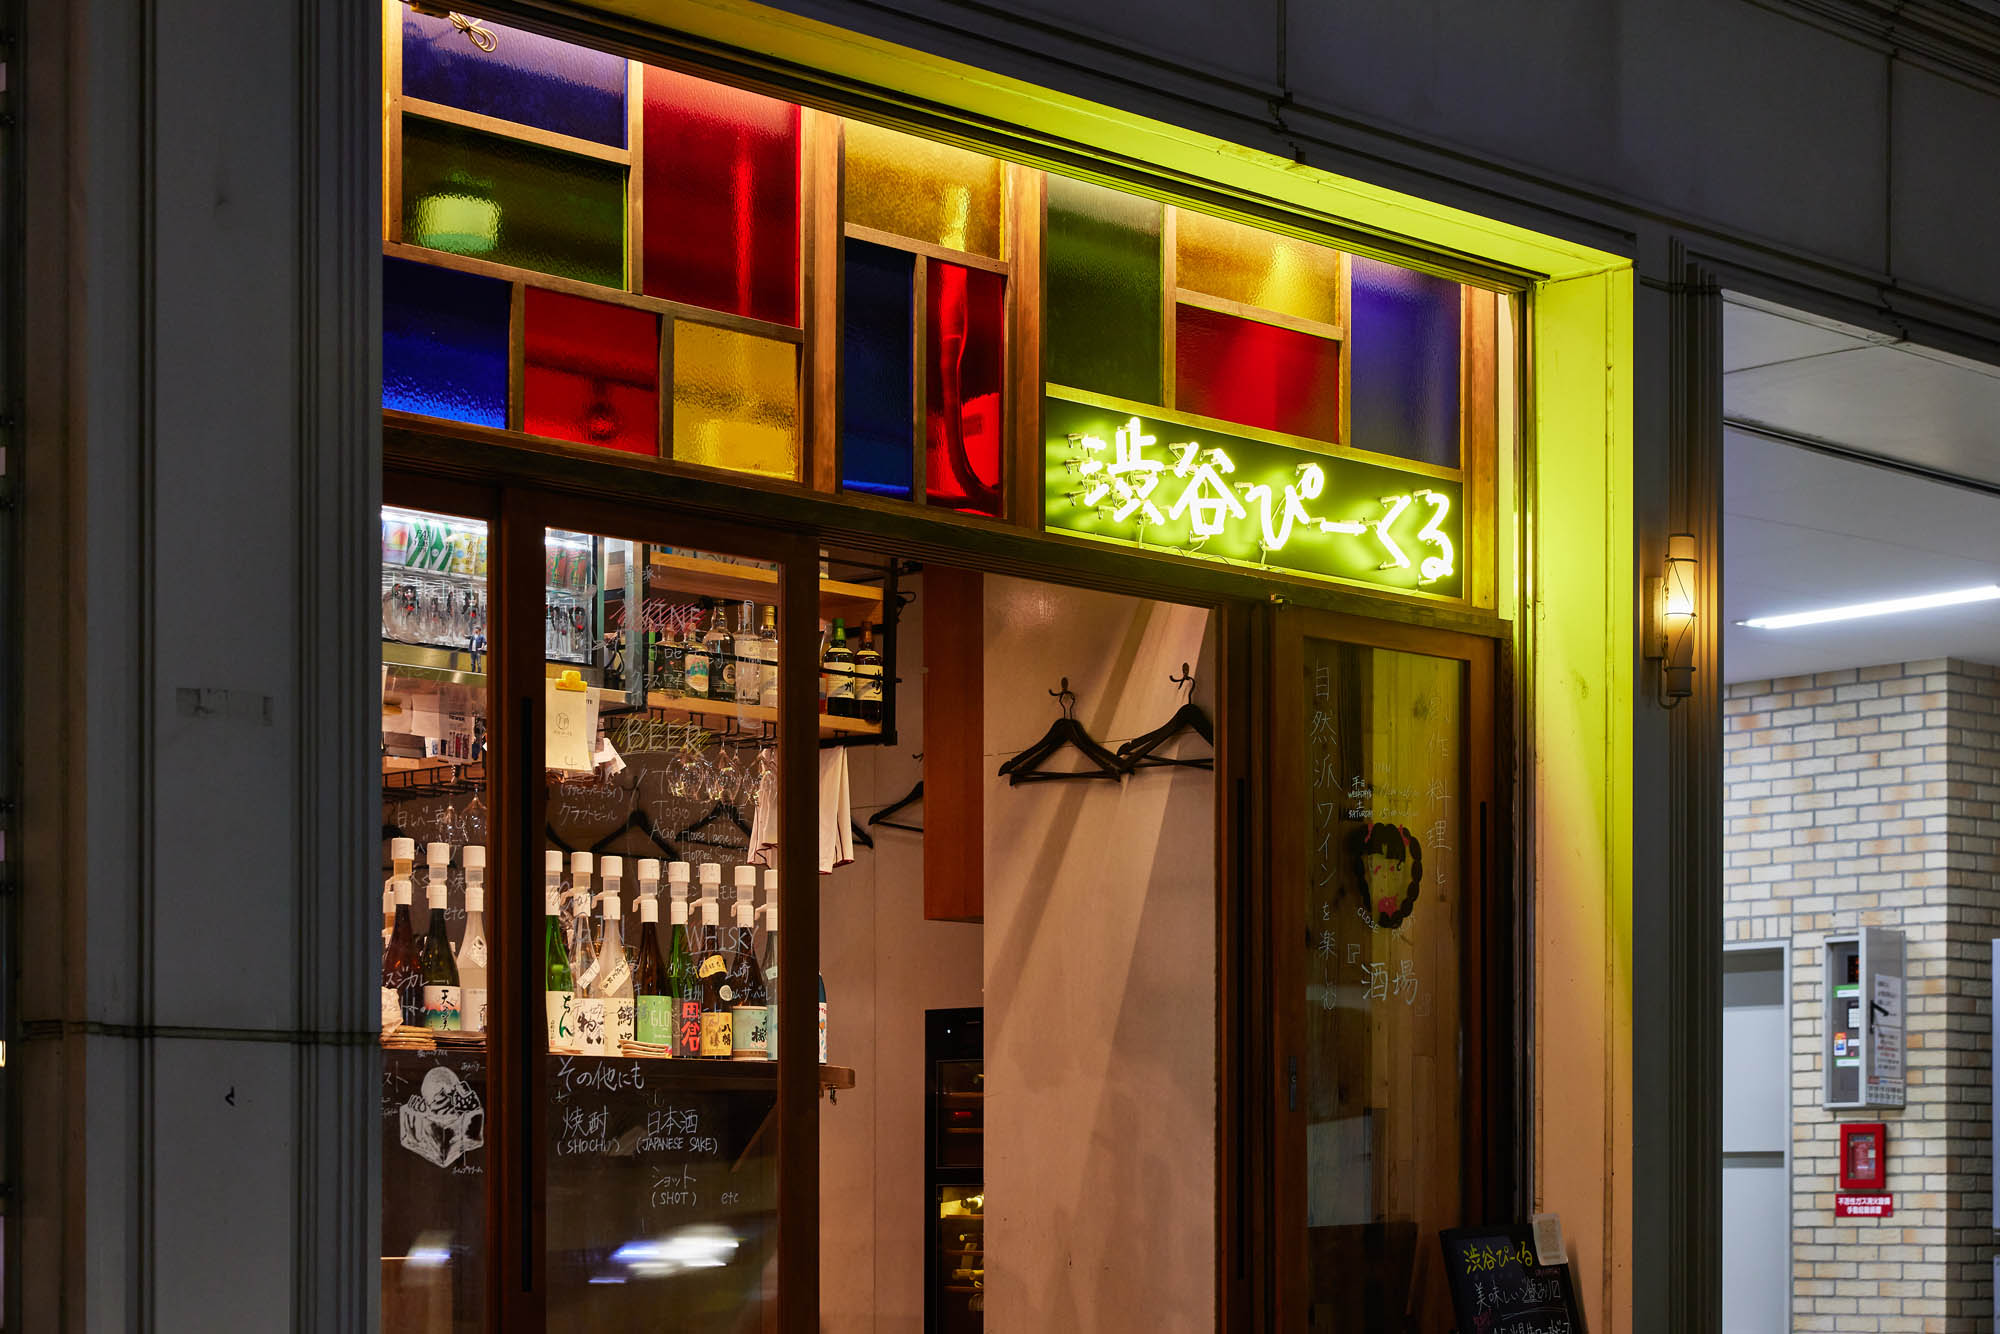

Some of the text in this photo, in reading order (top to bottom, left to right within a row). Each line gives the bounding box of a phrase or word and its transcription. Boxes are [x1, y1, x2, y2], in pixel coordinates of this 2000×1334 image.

[1080, 416, 1455, 580] 渋谷ぴーくる
[627, 719, 703, 756] BEER
[685, 922, 759, 958] WHISKY
[557, 1056, 645, 1092] その他にも
[563, 1105, 699, 1139] 焼酎 日本酒
[651, 1163, 697, 1189] ショット
[721, 1192, 739, 1205] etc
[1463, 1240, 1533, 1275] 渋谷ぴーくる
